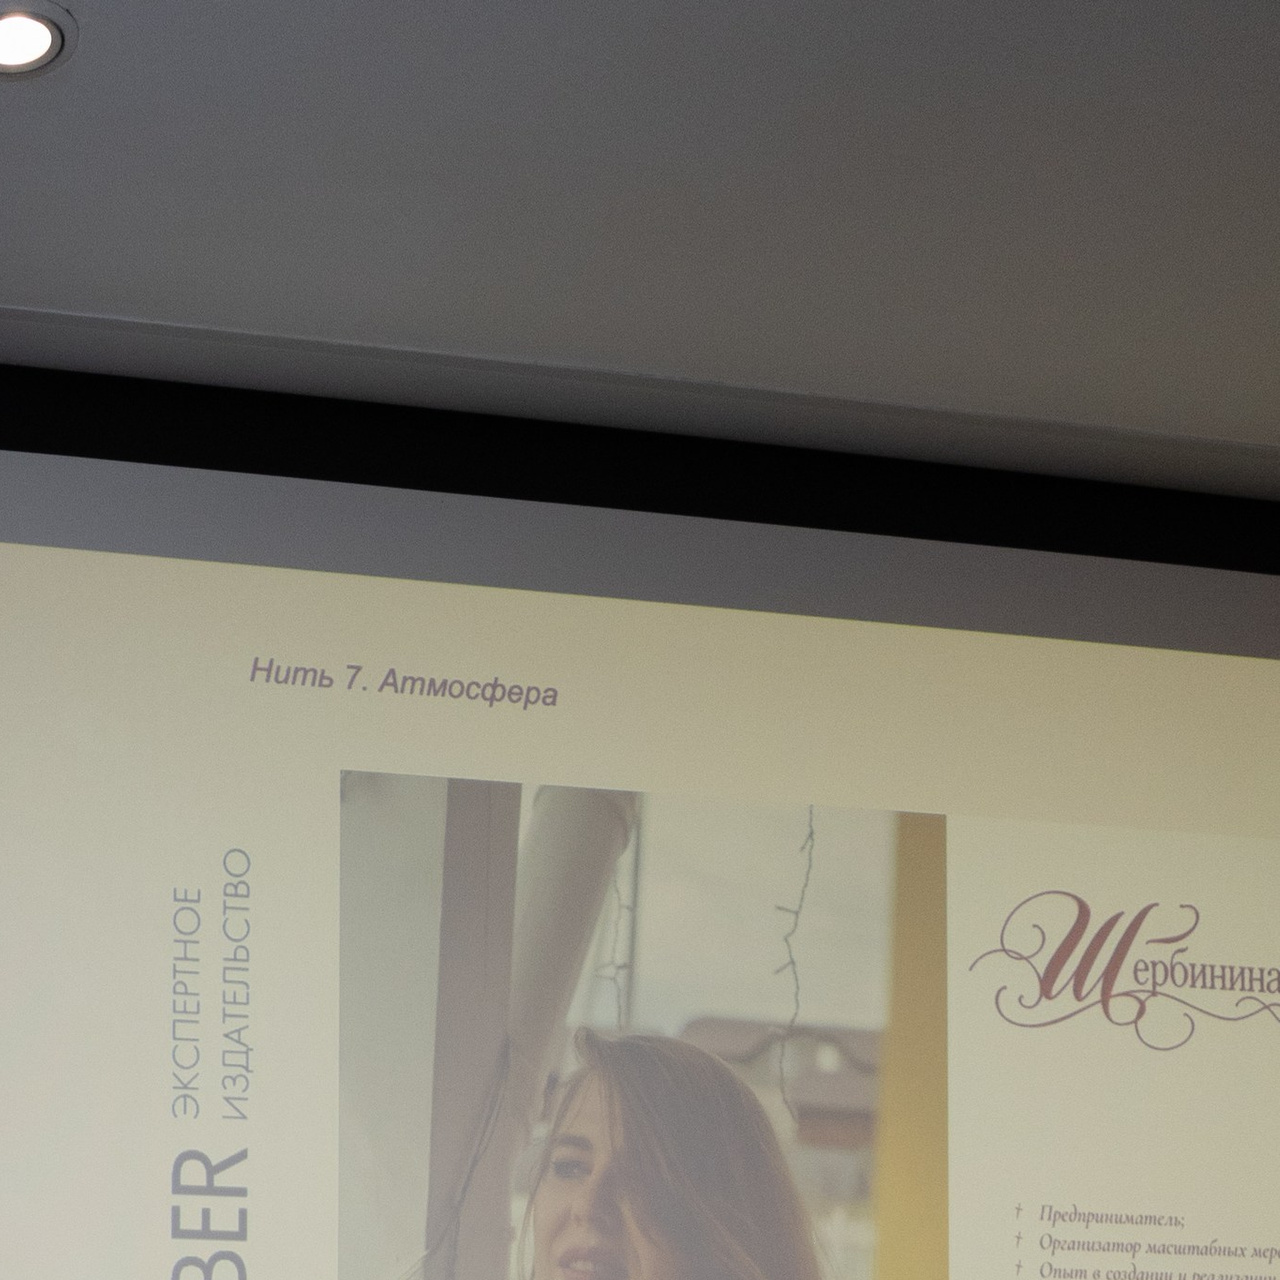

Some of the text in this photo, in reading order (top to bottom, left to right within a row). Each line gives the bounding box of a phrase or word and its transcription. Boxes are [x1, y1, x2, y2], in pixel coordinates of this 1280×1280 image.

[250, 657, 559, 710] Нить 7. Атмосфера
[172, 887, 201, 1119] ЭКСПЕРТНОЕ
[221, 848, 253, 1120] ИЗДАТЕЛЬСТВО
[1039, 1204, 1186, 1229] Предприниматель;
[1039, 1233, 1142, 1259] Организатор
[1145, 1238, 1248, 1259] масштабных
[1039, 1261, 1088, 1280] Опыт
[1092, 1271, 1101, 1280] в
